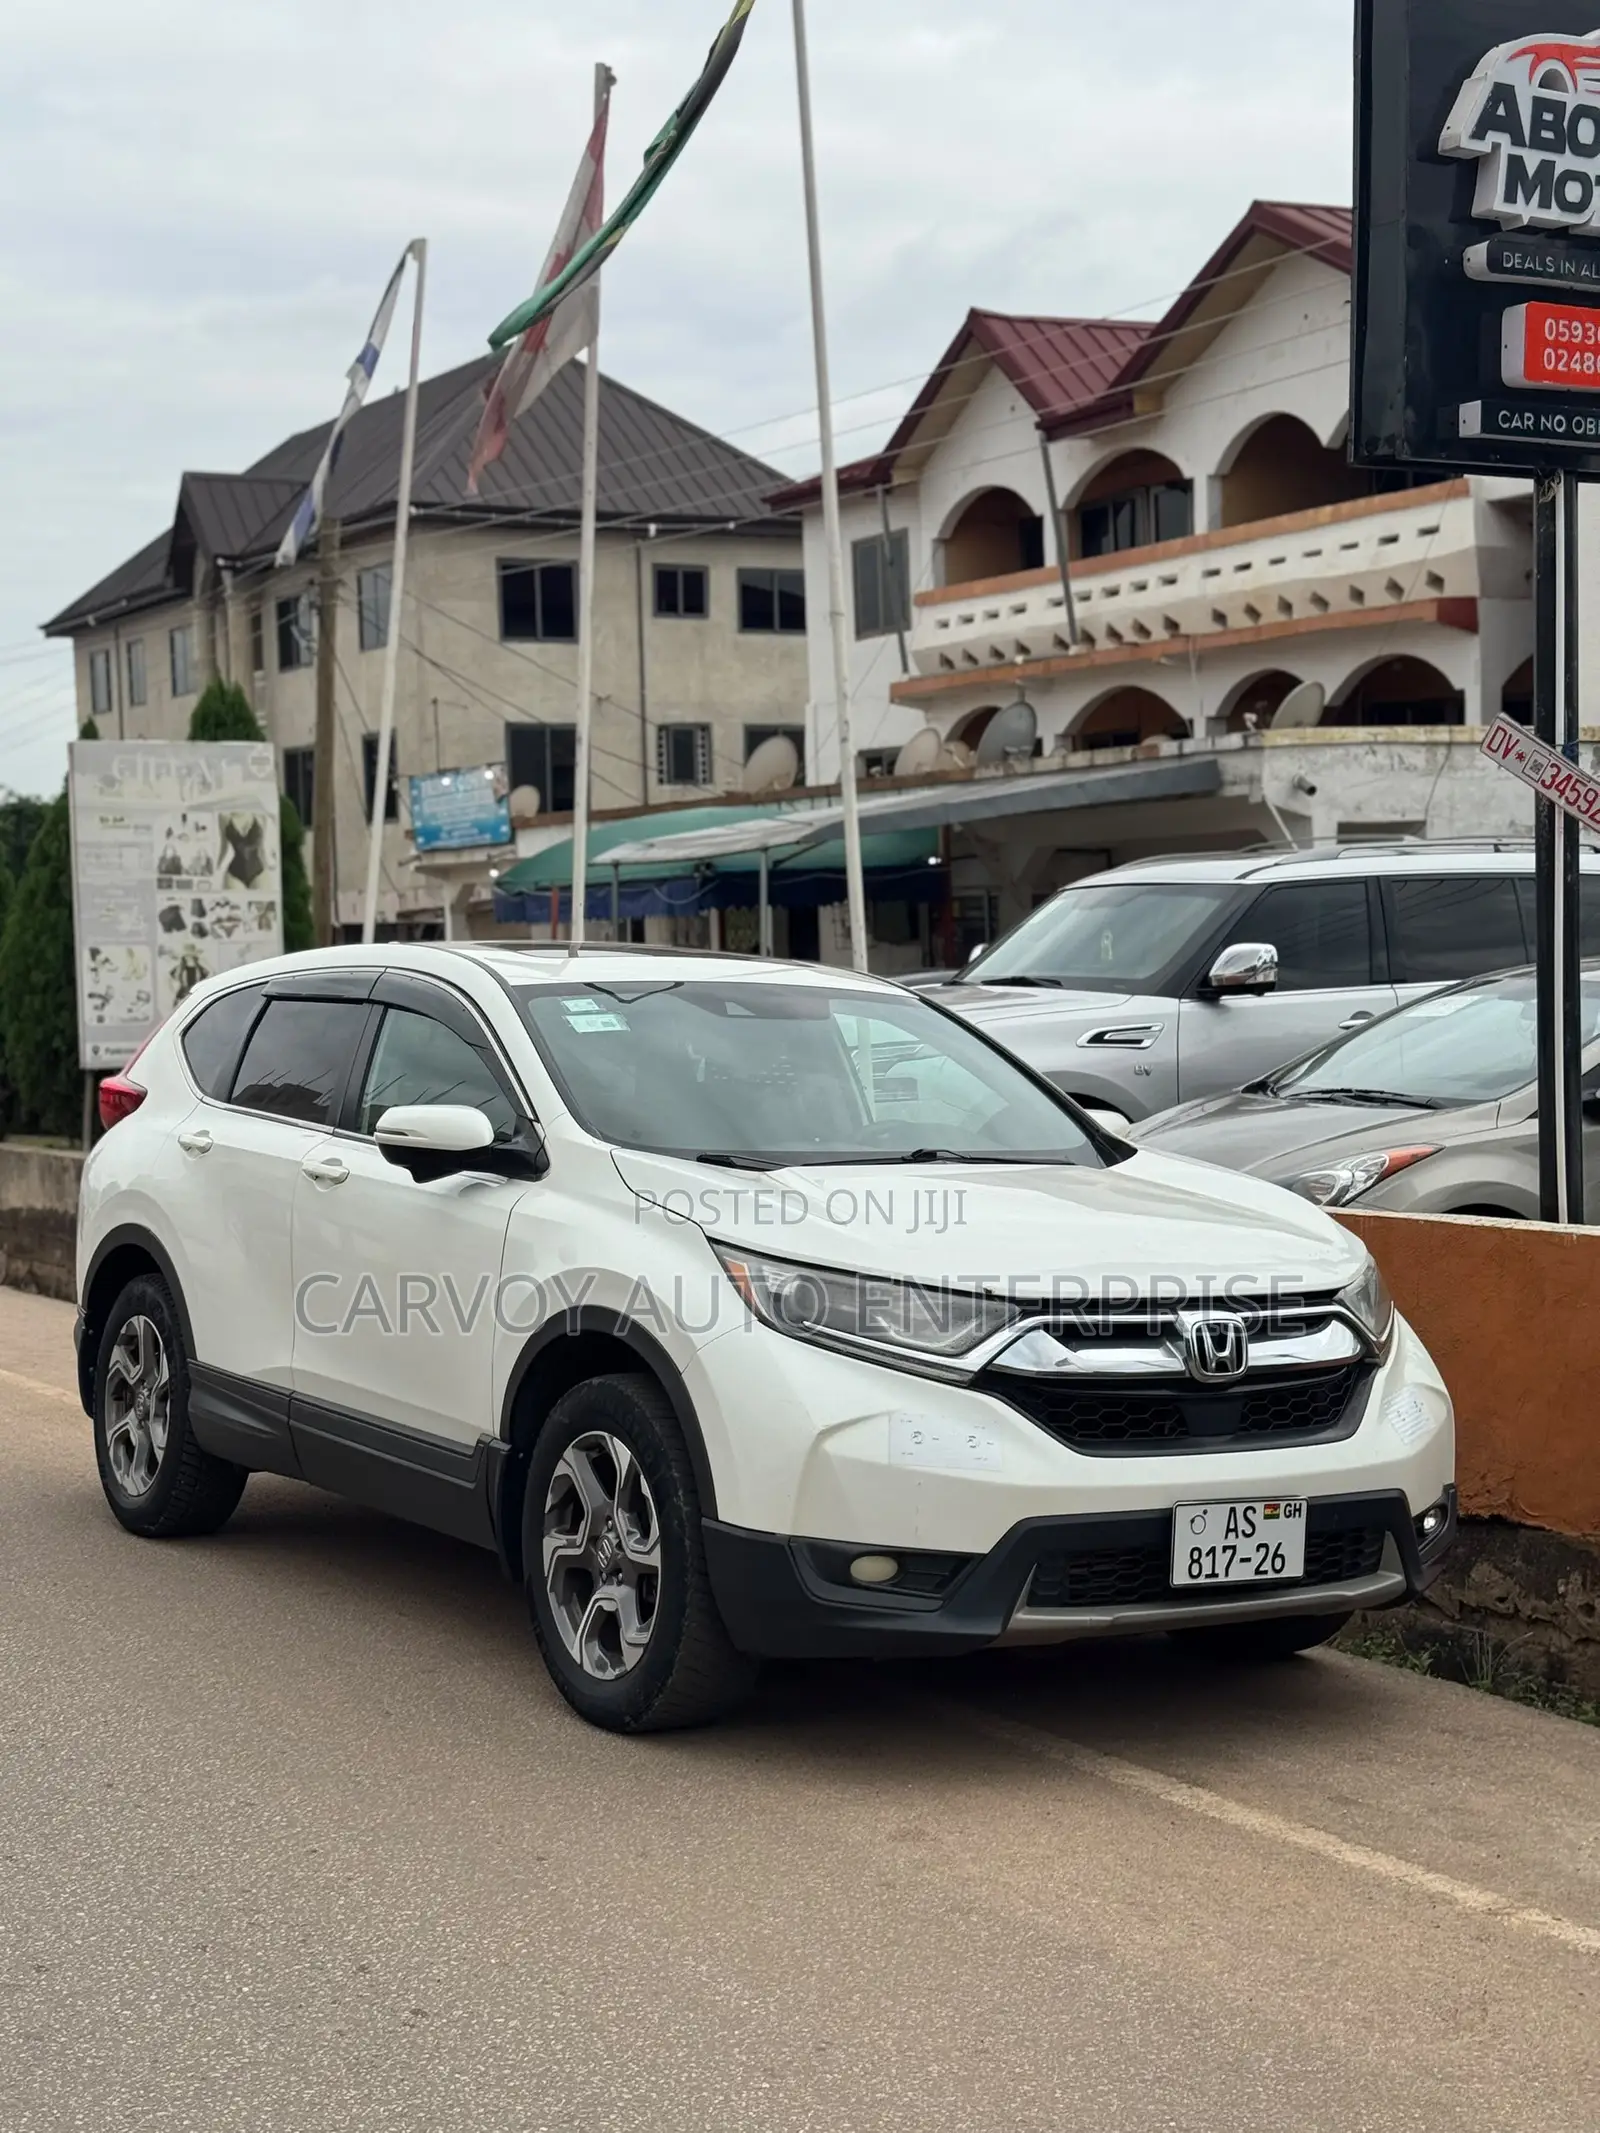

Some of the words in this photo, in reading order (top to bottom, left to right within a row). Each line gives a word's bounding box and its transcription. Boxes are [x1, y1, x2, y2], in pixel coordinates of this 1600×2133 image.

[1503, 252, 1555, 273] DEALS
[1560, 259, 1576, 275] IN
[1544, 317, 1600, 345] 0593
[1543, 347, 1600, 374] 0248
[1498, 410, 1535, 431] CAR
[1540, 414, 1567, 433] NO
[1572, 416, 1600, 435] OB
[1486, 725, 1520, 760] DV
[1224, 1505, 1257, 1541] AS
[1283, 1502, 1302, 1519] GH
[1187, 1541, 1286, 1580] 817-26
